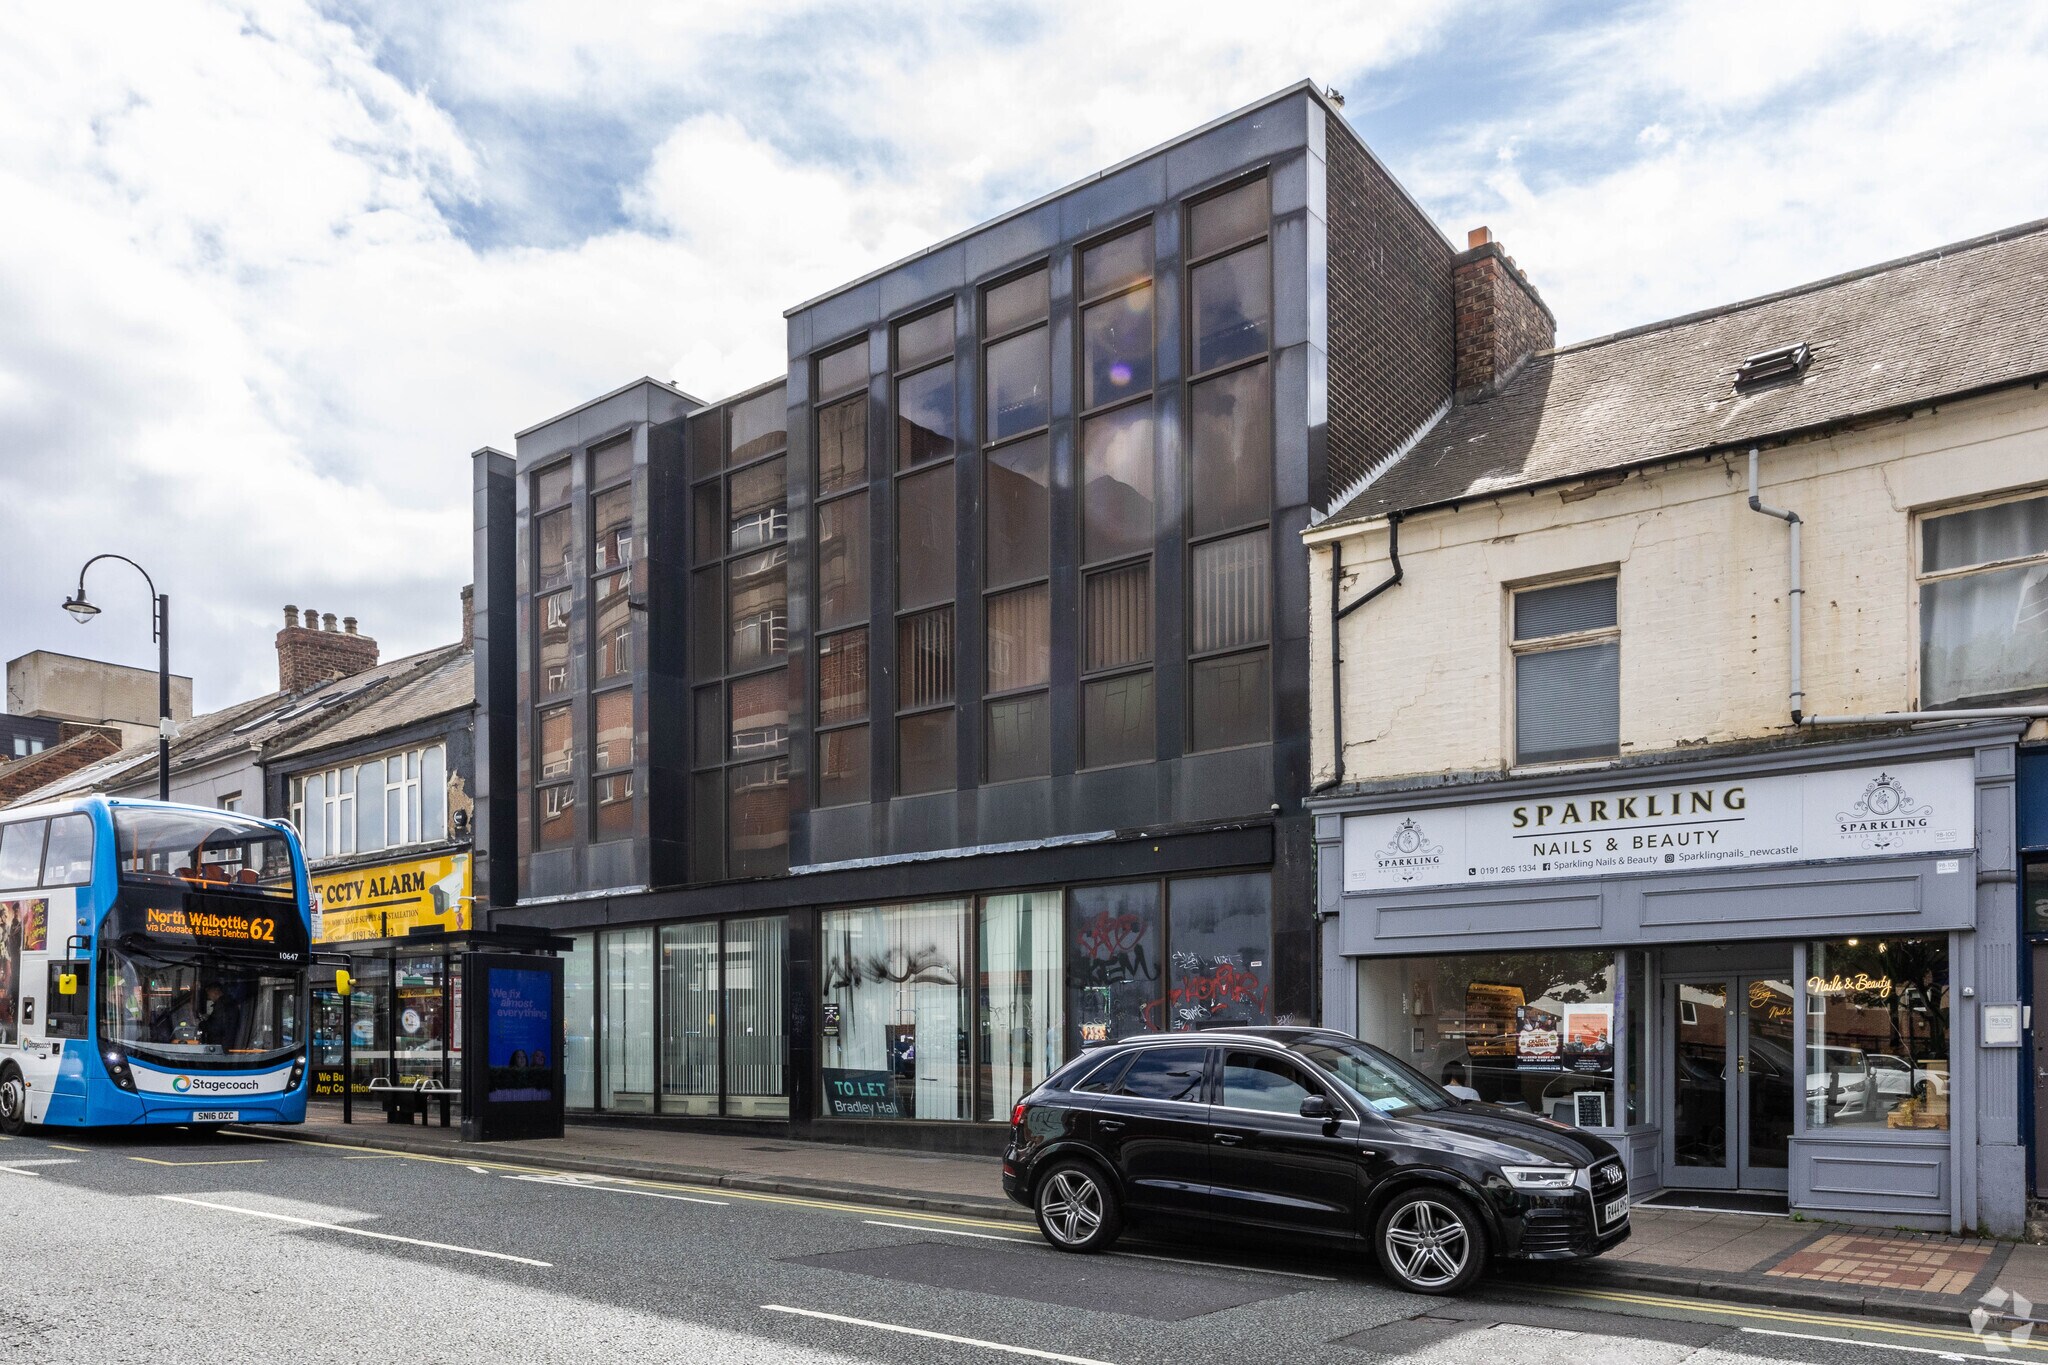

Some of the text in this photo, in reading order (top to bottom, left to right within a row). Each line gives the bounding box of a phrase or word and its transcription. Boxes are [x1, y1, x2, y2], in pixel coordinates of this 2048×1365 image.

[1512, 787, 1746, 828] SPARKLING
[1840, 818, 1928, 832] SPARKLING
[1533, 829, 1720, 856] NAILS & BEAUTY
[1378, 856, 1440, 867] SPARKLING
[1480, 845, 1799, 875] 0191 265 1334 Sparkling Nails & Beauty Sparklingnails_newcastle
[326, 880, 364, 903] CCTV
[368, 871, 425, 898] ALARM
[147, 908, 248, 930] North Walbottle
[146, 923, 249, 939] via Cowgate & West Denton
[250, 917, 275, 941] 62
[352, 930, 366, 941] 0191
[279, 952, 299, 961] 10647
[1807, 973, 1893, 998] Nails & Beauty
[491, 988, 521, 999] We fix
[500, 998, 534, 1008] almost
[497, 1008, 548, 1020] everything
[28, 1040, 51, 1051] Stagecoach
[318, 1072, 344, 1082] We Bu
[192, 1078, 259, 1092] Stagecoach
[315, 1083, 331, 1095] Any
[834, 1081, 886, 1097] TO LET
[198, 1111, 234, 1120] SN16 OZC
[834, 1100, 899, 1117] Bradley Hall
